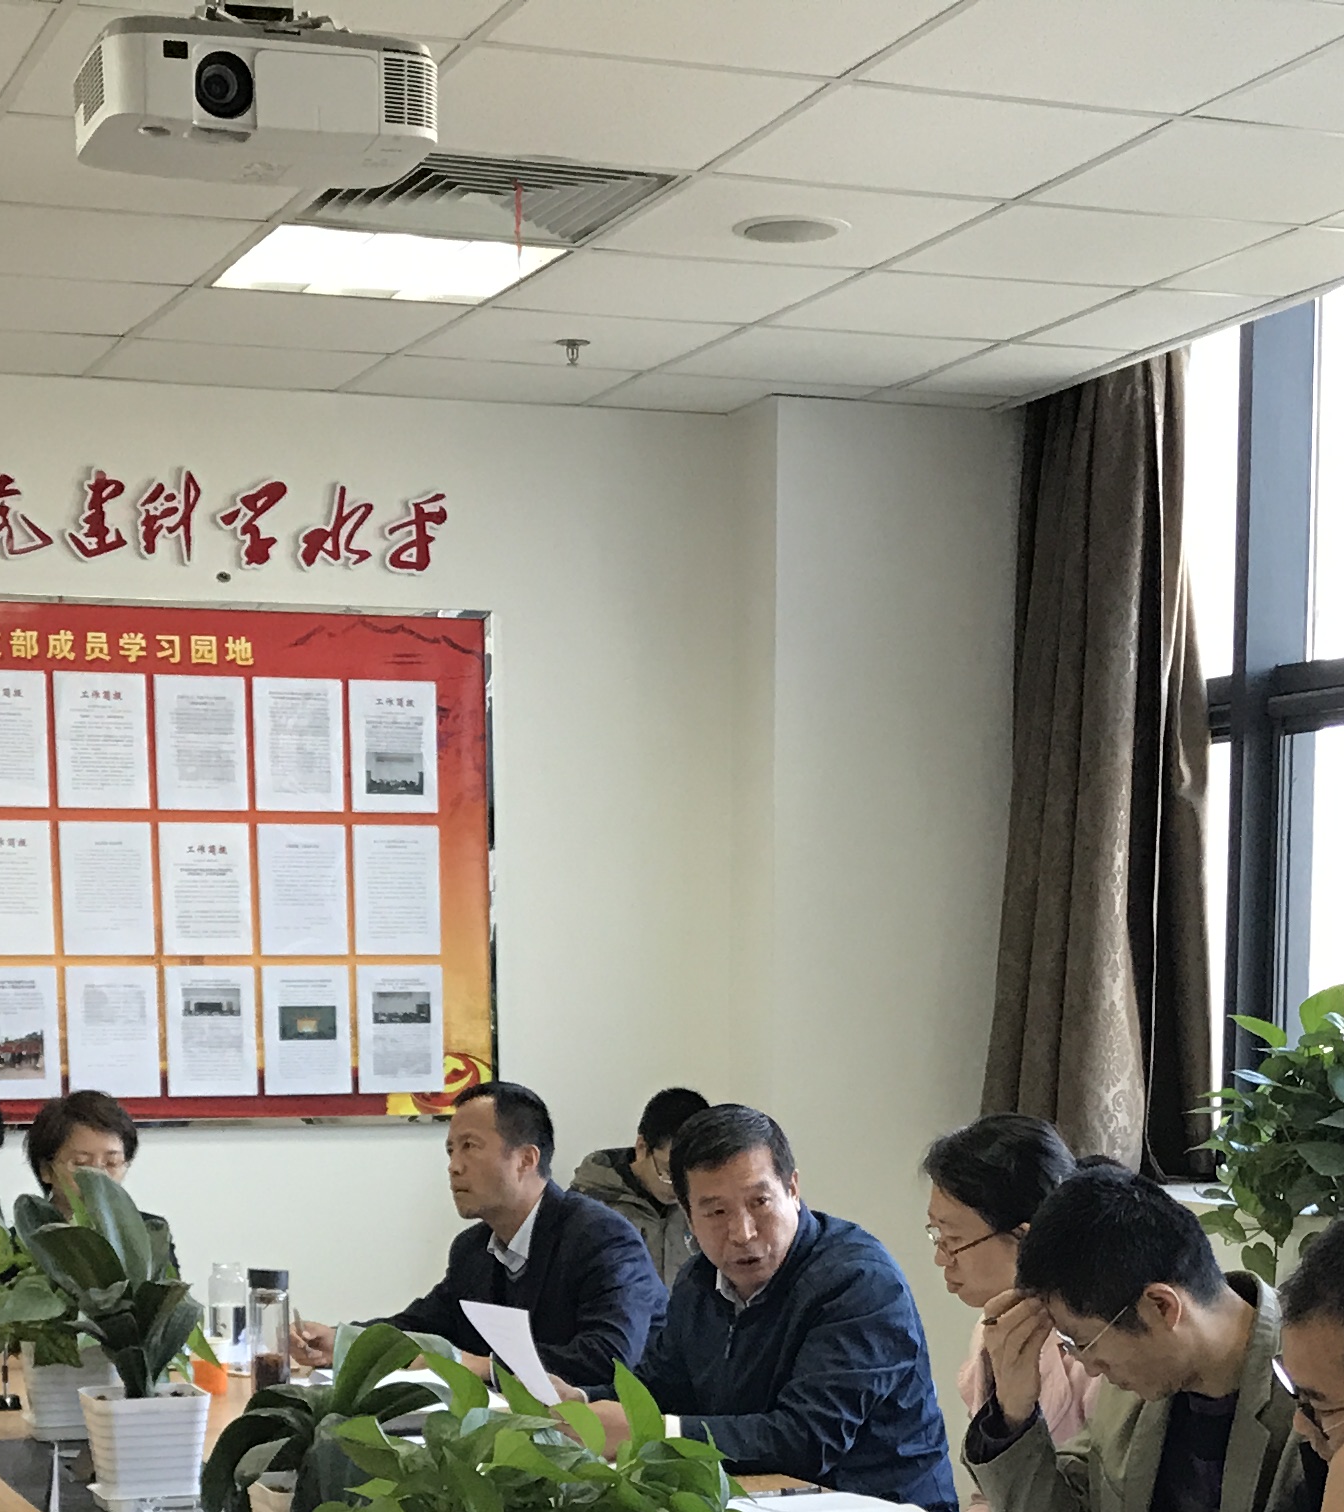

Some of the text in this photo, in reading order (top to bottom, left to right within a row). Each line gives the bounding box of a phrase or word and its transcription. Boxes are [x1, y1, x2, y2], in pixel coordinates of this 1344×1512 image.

[80, 690, 124, 702] 工作简报
[375, 697, 416, 708] 工作简报
[186, 844, 228, 856] 工作简报
